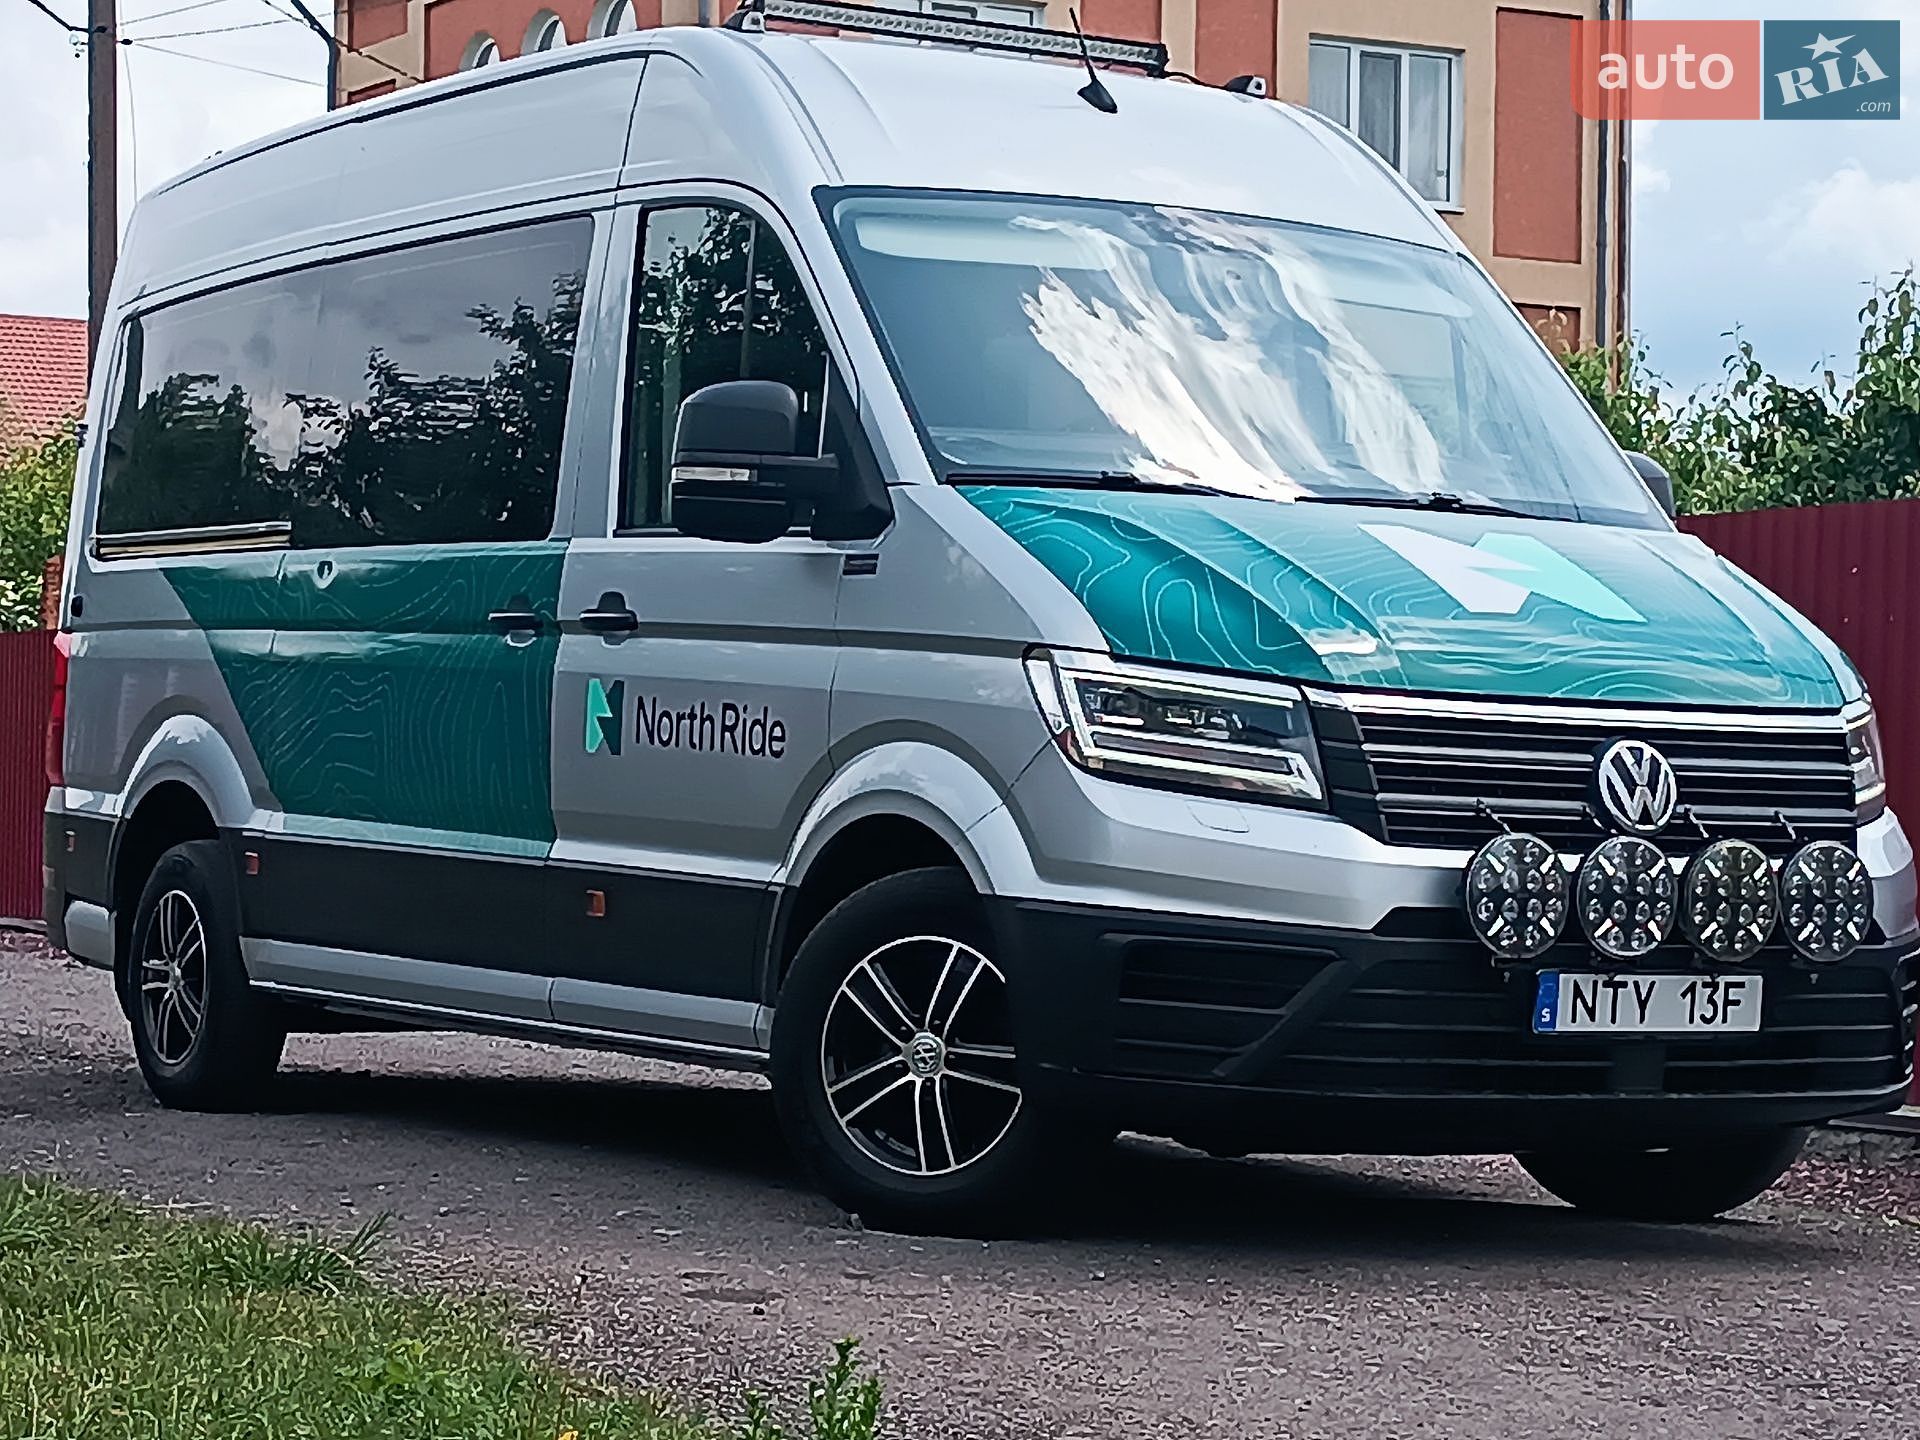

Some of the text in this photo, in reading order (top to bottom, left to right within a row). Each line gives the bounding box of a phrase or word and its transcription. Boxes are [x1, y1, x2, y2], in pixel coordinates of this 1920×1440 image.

[1541, 1007, 1551, 1023] S
[1570, 979, 1746, 1025] NTY 13F
